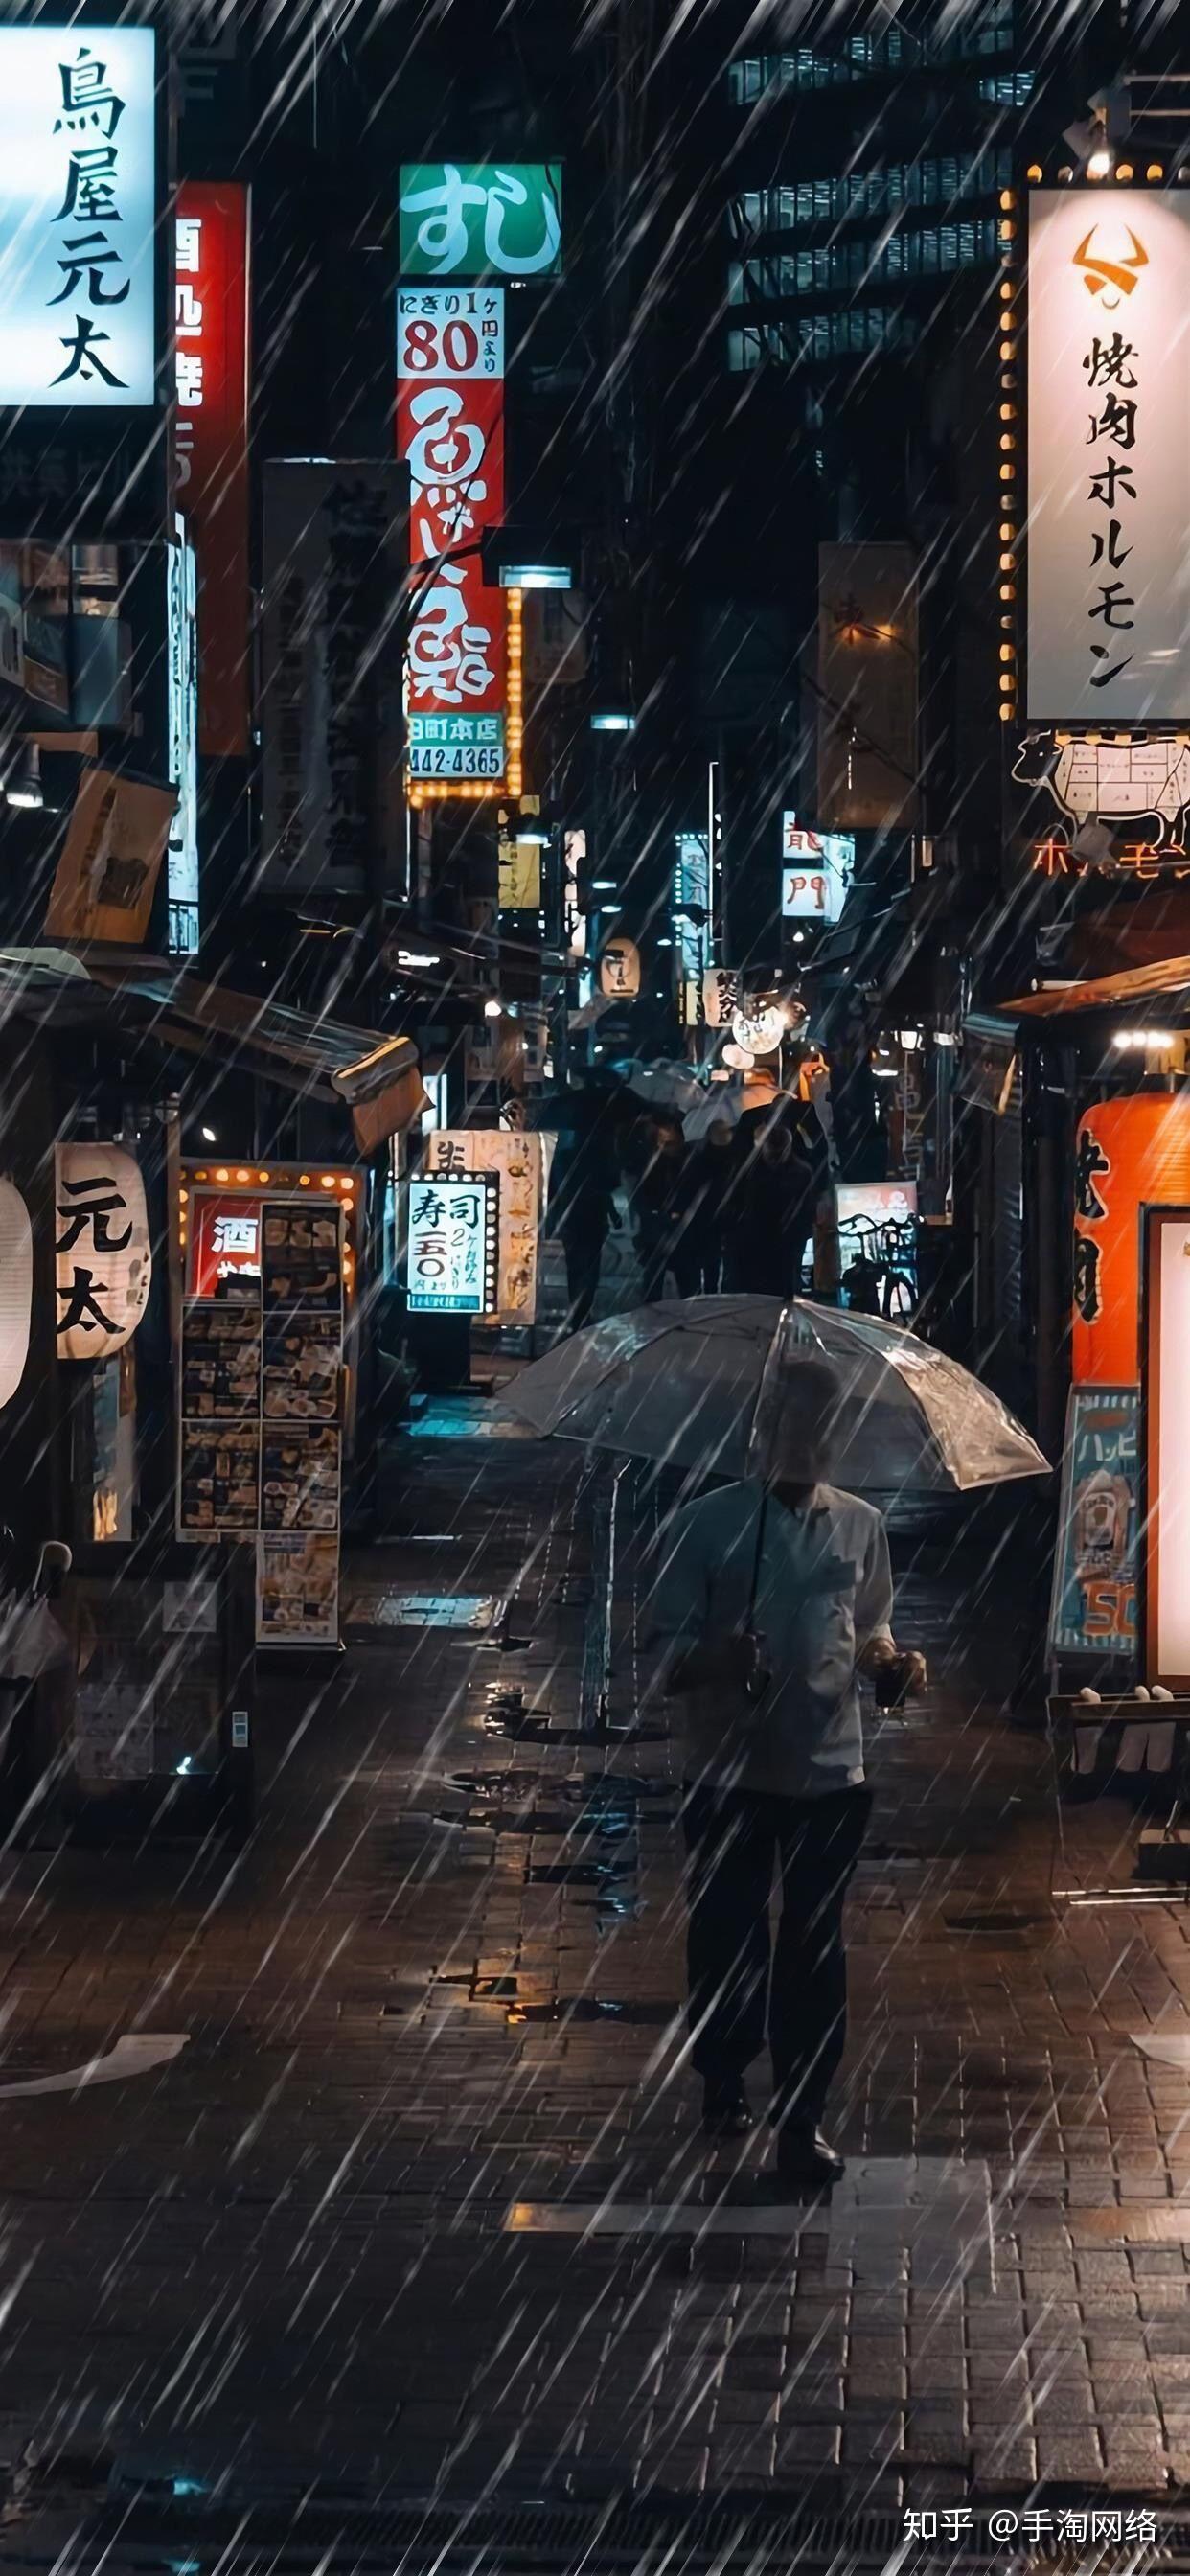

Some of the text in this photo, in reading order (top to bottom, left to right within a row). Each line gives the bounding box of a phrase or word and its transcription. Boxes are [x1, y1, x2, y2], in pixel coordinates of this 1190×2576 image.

[45, 47, 131, 389] 鳥屋元太
[400, 164, 561, 275] すし
[402, 319, 479, 373] 80
[1082, 332, 1139, 688] 焼肉ホルモン
[56, 1177, 133, 1334] 元太
[412, 1189, 481, 1229] 寿司
